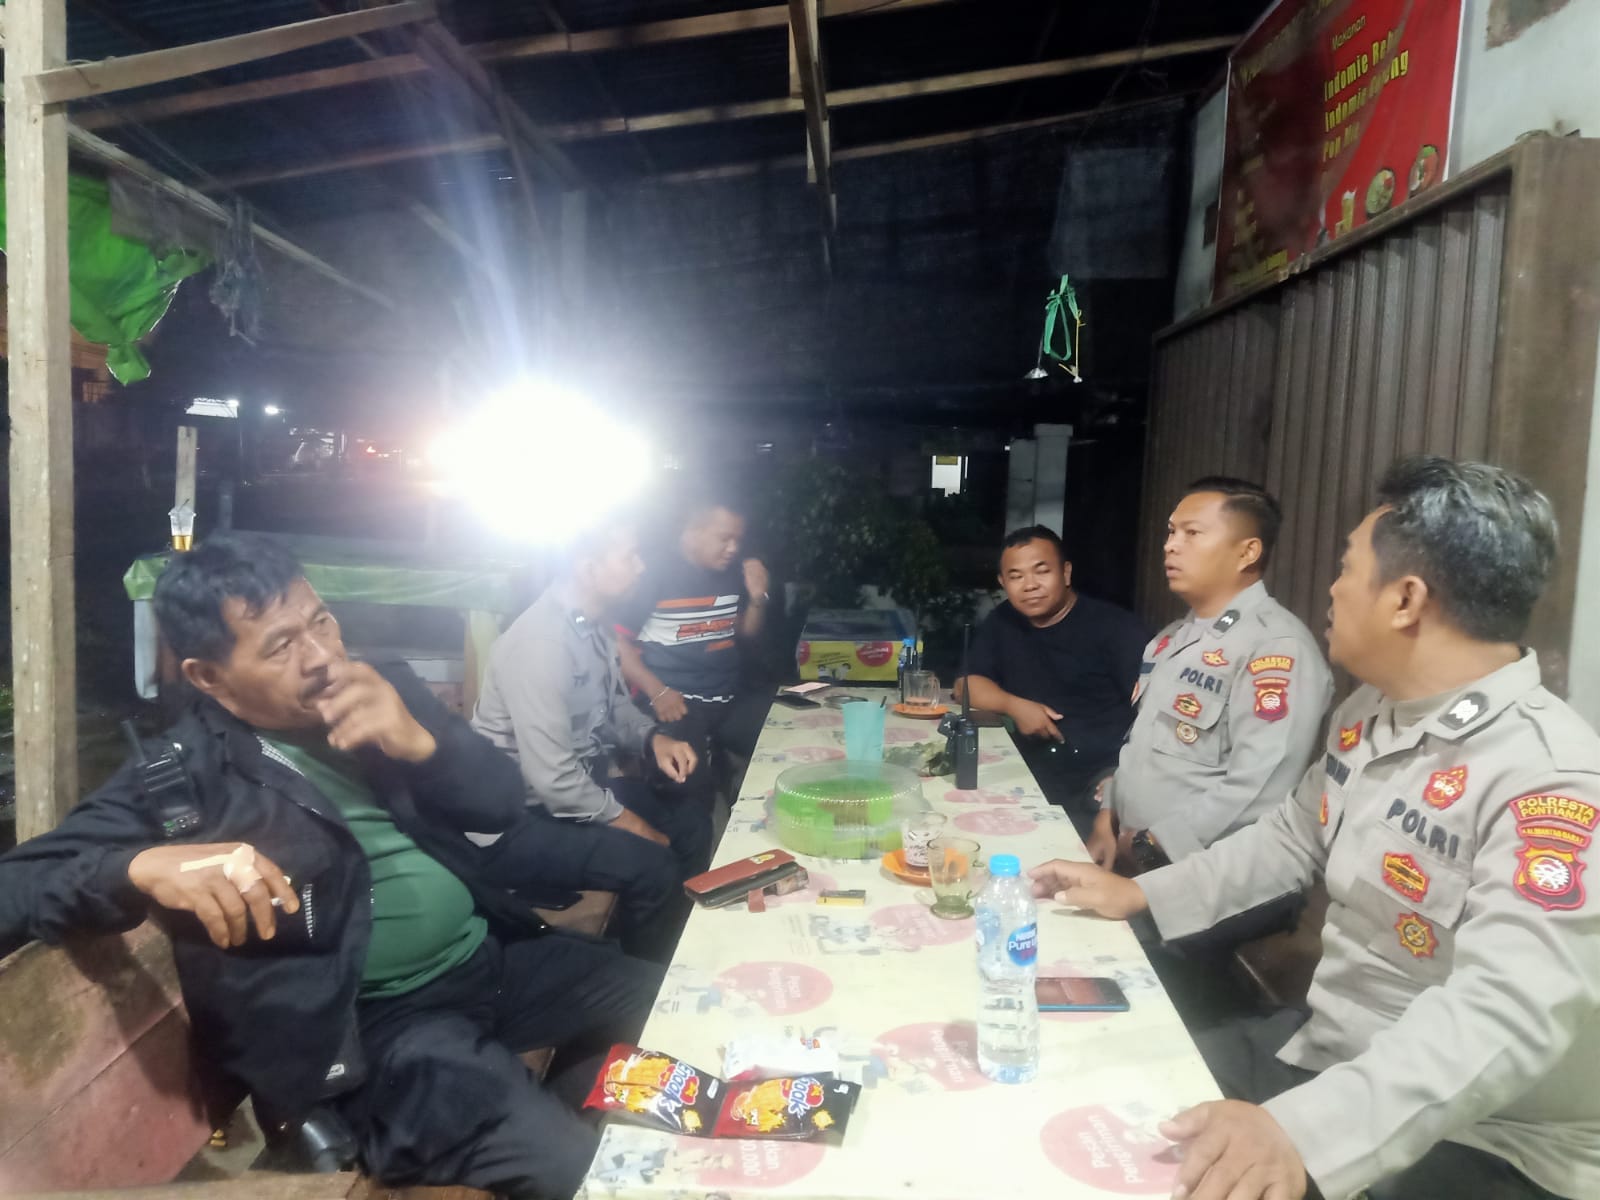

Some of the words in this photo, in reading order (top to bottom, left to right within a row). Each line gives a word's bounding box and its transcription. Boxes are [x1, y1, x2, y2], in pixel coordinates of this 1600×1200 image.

[1324, 54, 1369, 101] Indomie
[1372, 28, 1402, 67] Reb
[1325, 87, 1367, 133] Indomie
[1180, 667, 1223, 694] POLRI
[1517, 796, 1595, 819] POLRESTA
[1521, 806, 1590, 825] PONTIANAK
[1386, 798, 1459, 859] POLRI
